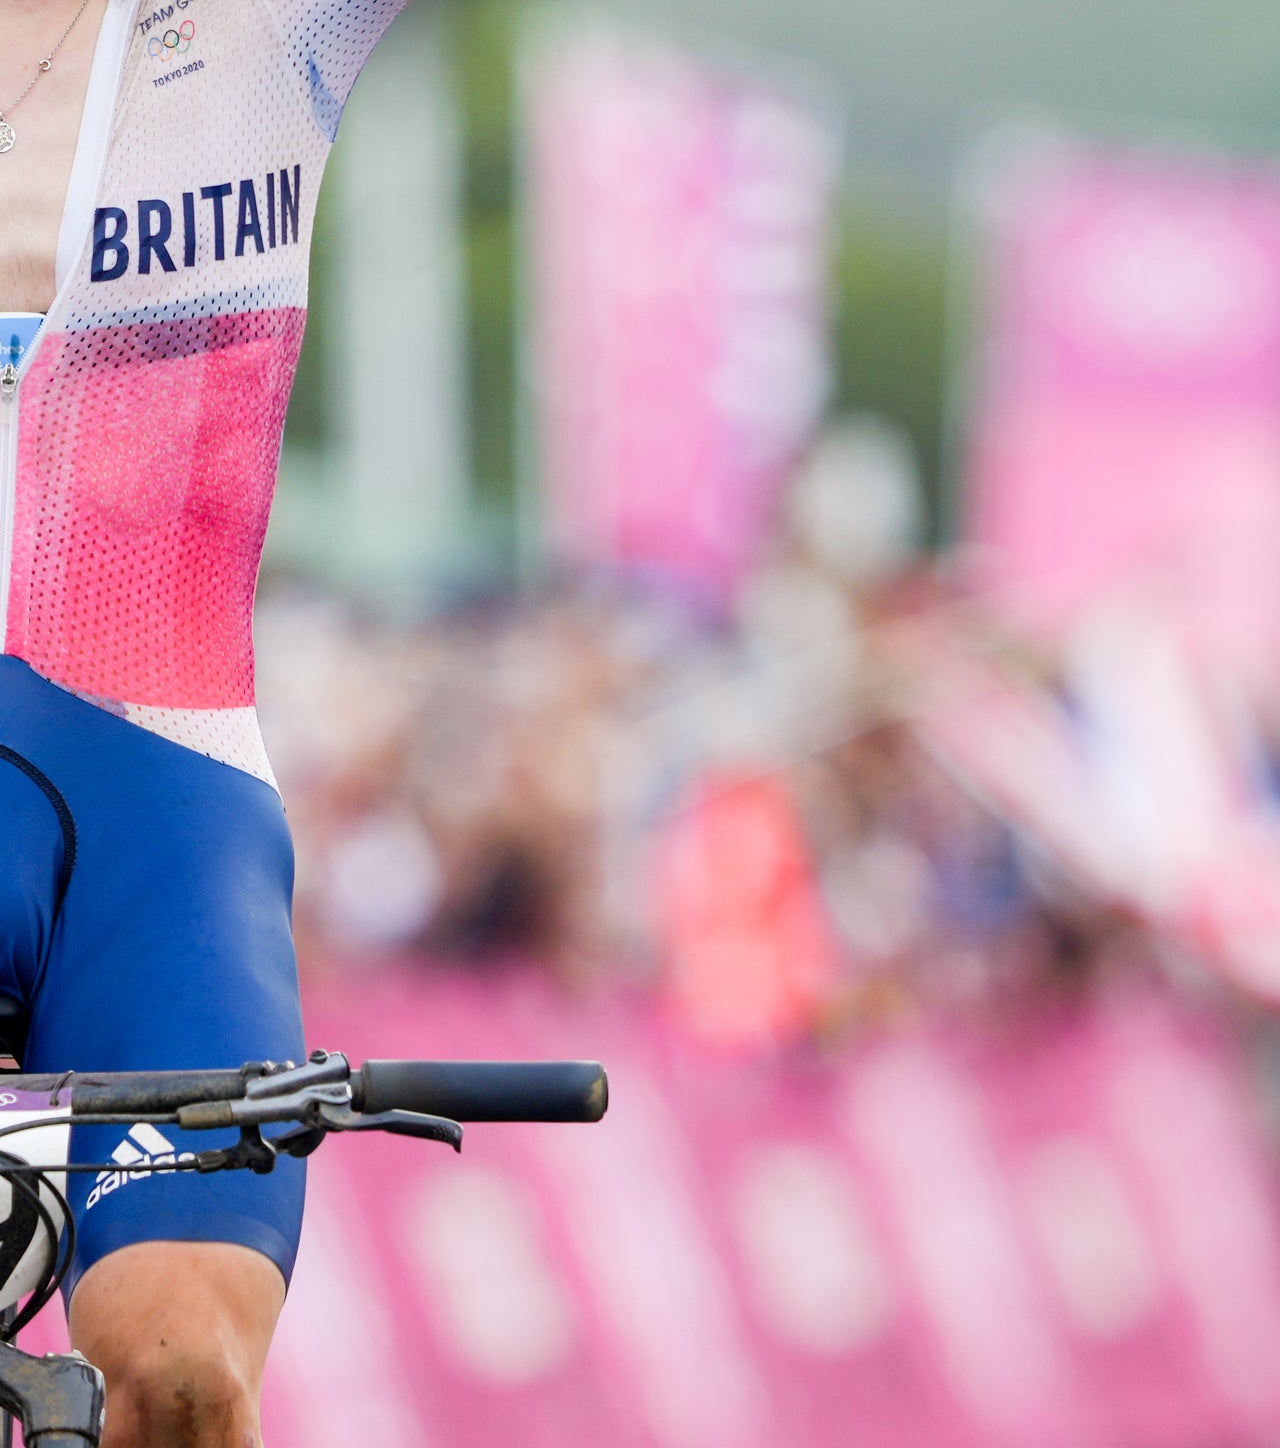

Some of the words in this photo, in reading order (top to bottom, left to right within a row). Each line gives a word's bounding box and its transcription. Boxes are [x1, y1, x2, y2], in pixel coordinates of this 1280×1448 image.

[139, 5, 174, 35] TEAM
[152, 69, 182, 88] TOKYO
[182, 59, 205, 75] 2020
[90, 164, 300, 283] BRITAIN
